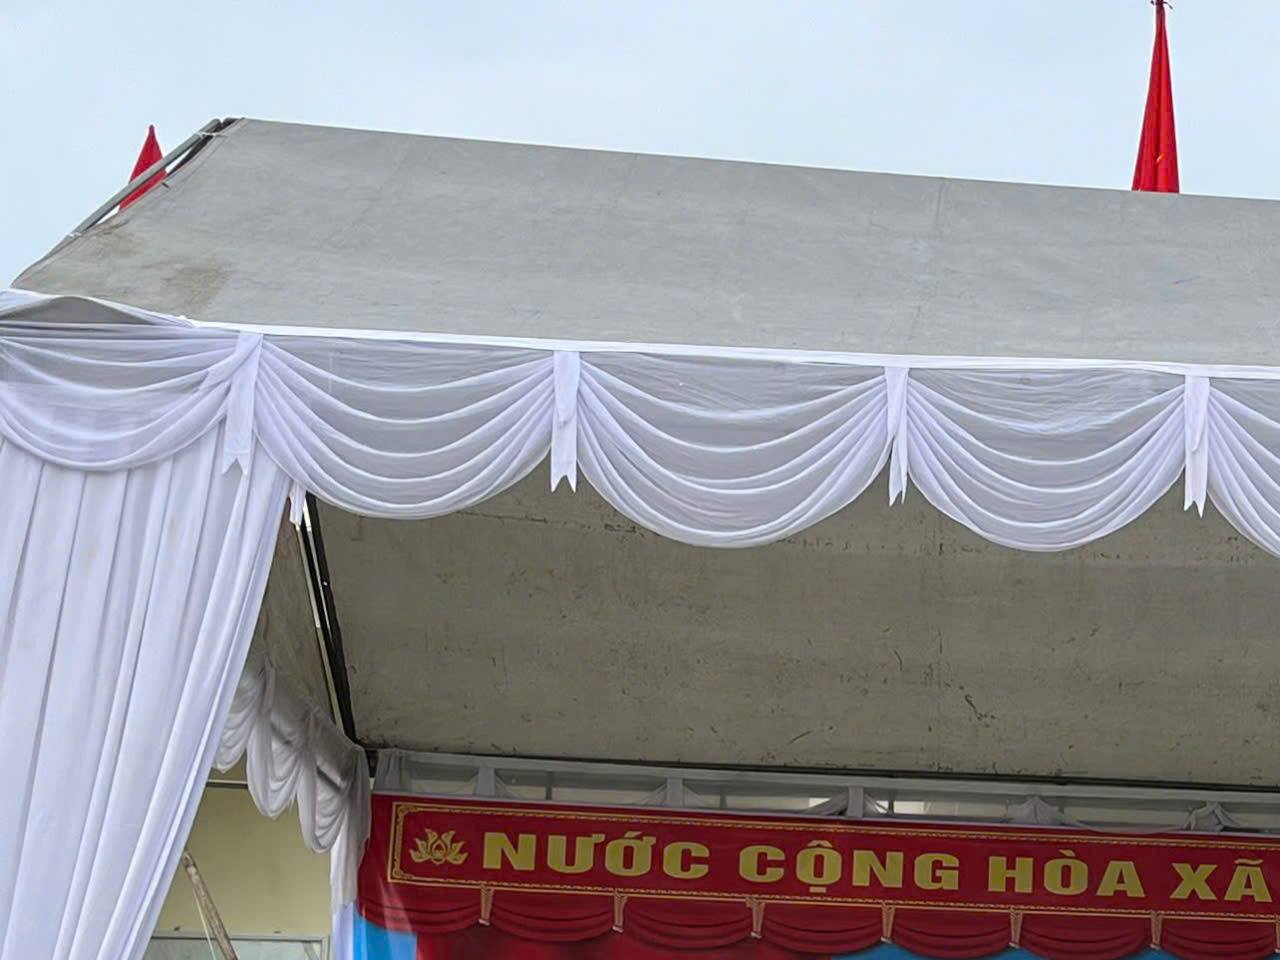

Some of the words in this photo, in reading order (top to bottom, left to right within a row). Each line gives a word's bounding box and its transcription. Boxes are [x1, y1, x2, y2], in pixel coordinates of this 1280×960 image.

[482, 831, 710, 880] NƯỚC
[738, 840, 961, 893] CỘNG
[987, 848, 1146, 898] HÒA
[1172, 858, 1273, 902] XÃ
